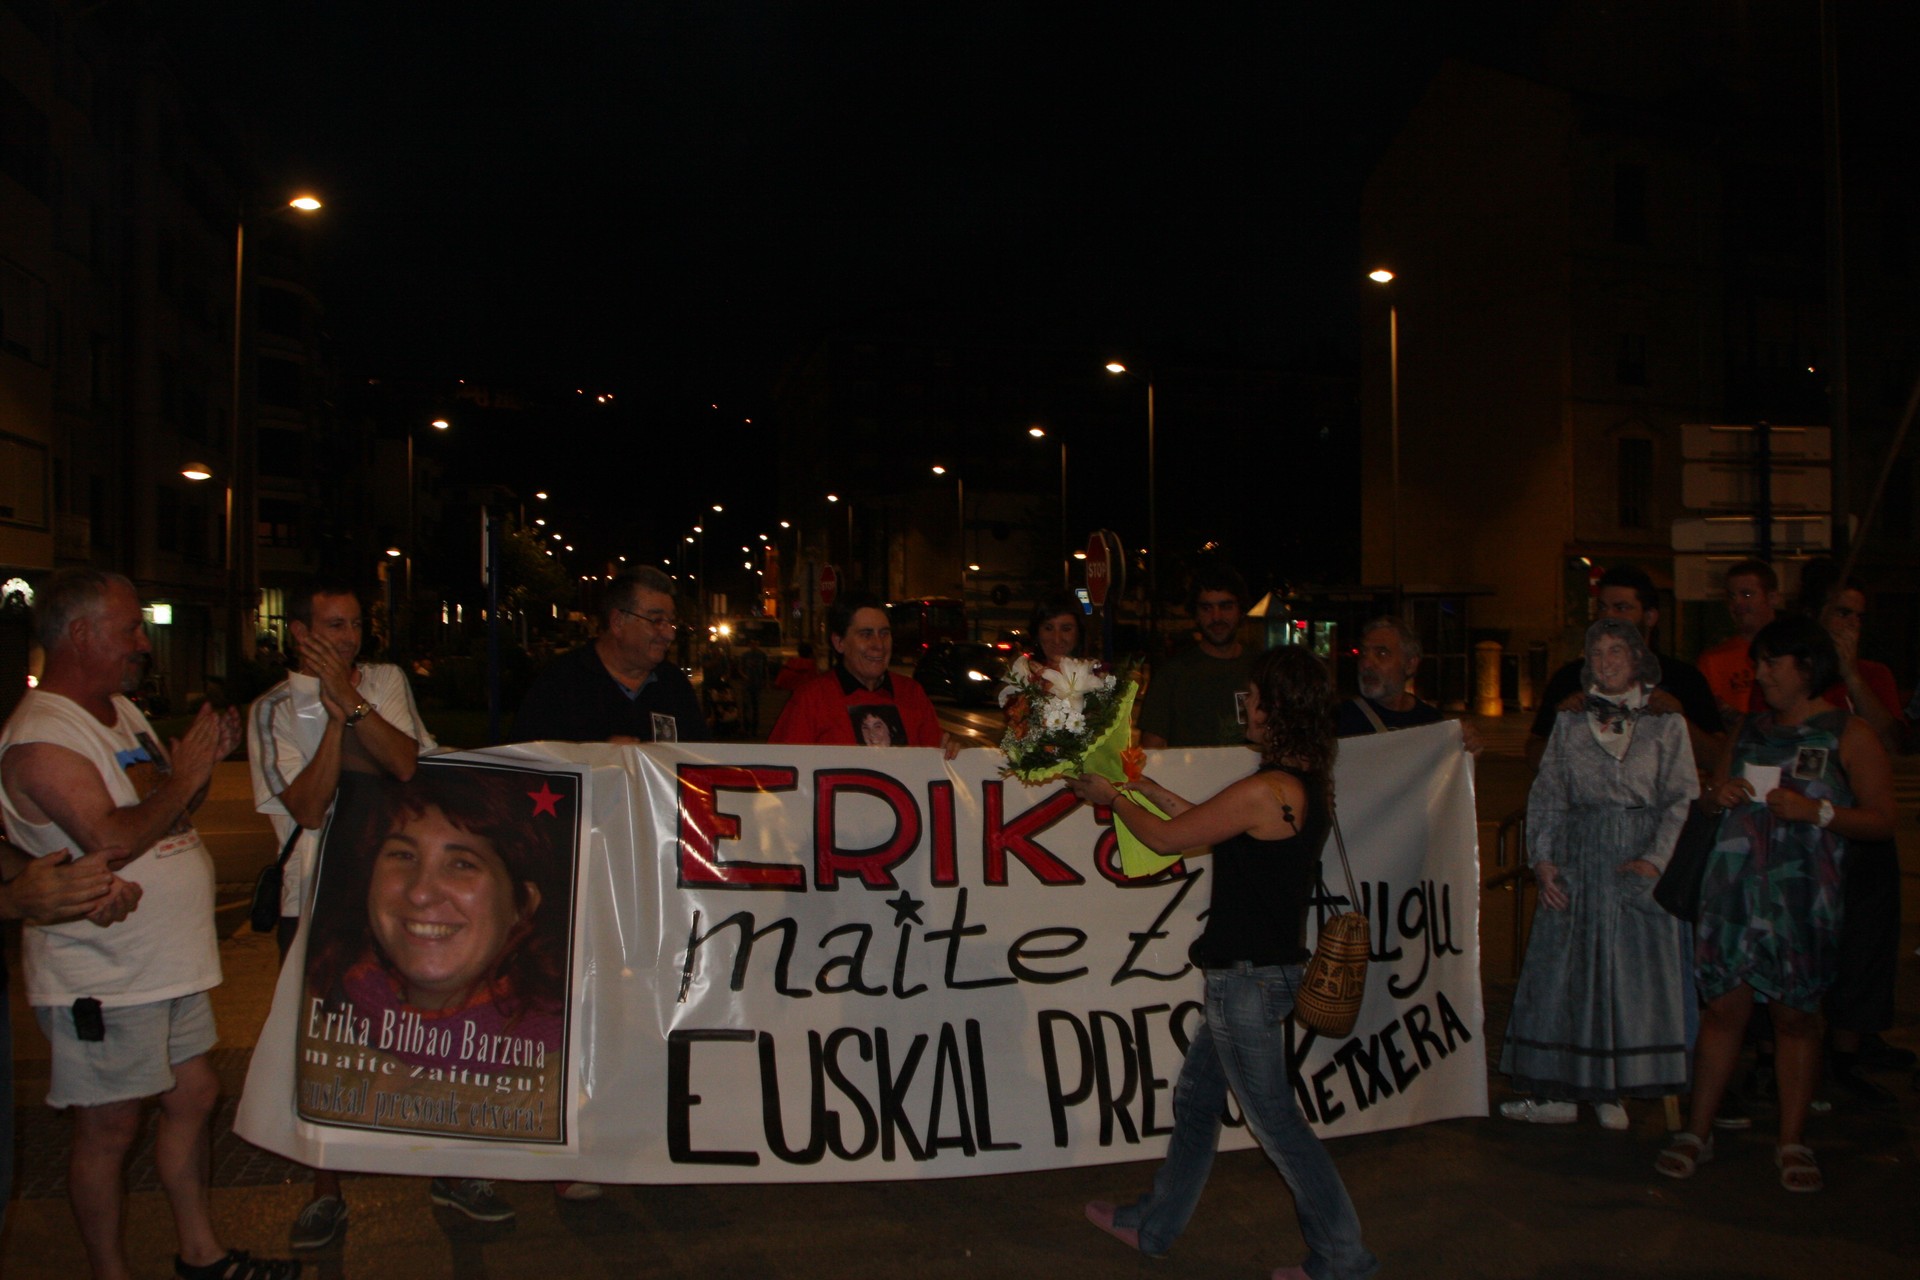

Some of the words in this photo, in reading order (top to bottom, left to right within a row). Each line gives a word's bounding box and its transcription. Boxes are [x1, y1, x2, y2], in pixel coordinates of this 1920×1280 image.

[1088, 561, 1107, 578] STOP
[678, 888, 1088, 1003] maite
[308, 997, 370, 1047] Erika
[379, 1008, 452, 1058] Bilbao
[459, 1019, 545, 1069] Barzena
[305, 1048, 396, 1075] maite
[410, 1065, 545, 1094] zaitugu!
[668, 1018, 1022, 1166] EUSKAL
[372, 1089, 460, 1127] presoak
[468, 1097, 545, 1133] etxera!
